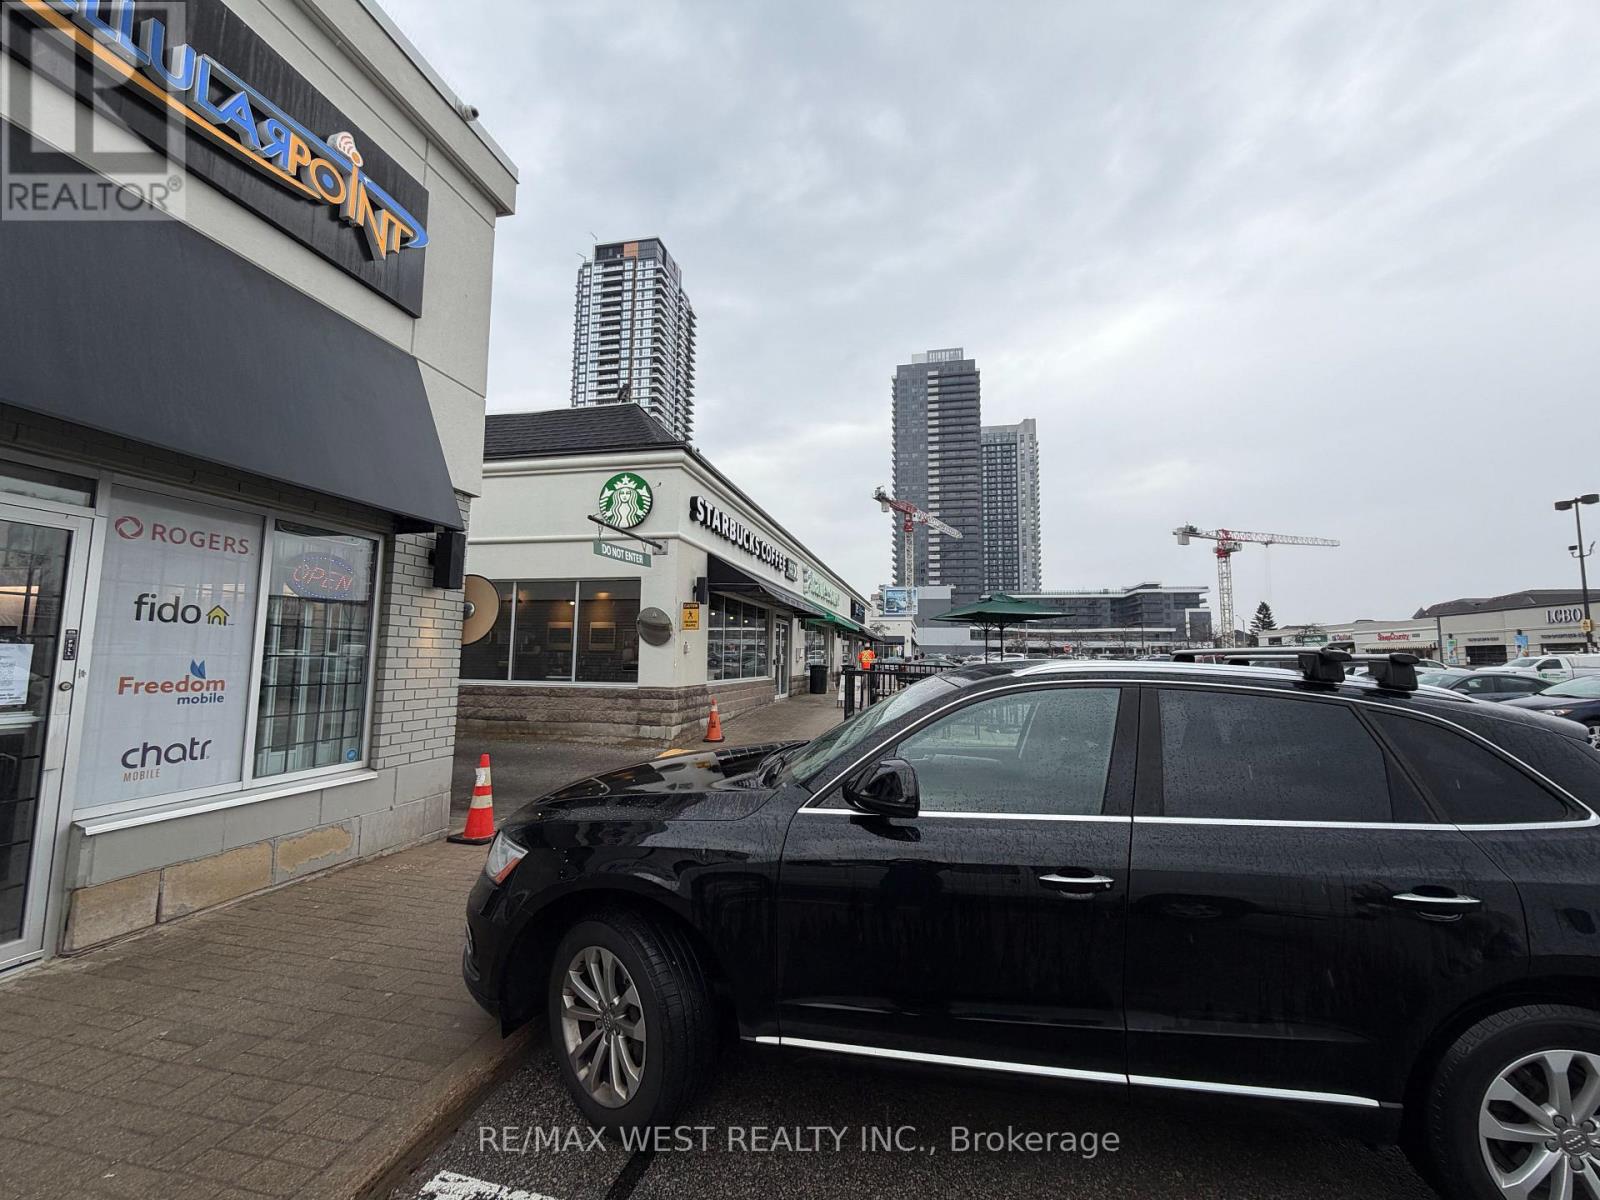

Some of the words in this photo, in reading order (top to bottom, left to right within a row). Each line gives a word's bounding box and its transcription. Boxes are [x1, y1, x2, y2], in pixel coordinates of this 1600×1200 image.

[151, 523, 249, 555] ROGERS
[692, 496, 761, 556] STARBUCKS
[761, 540, 787, 572] COFFEE
[601, 544, 612, 556] DO
[612, 547, 625, 559] NOT
[625, 551, 644, 564] ENTER
[293, 565, 353, 592] OPEN
[134, 593, 202, 624] fido
[1545, 608, 1583, 624] LCBO
[118, 675, 226, 695] Freedom
[177, 693, 225, 705] mobile
[121, 737, 212, 769] chatr
[123, 768, 161, 783] MOBILE
